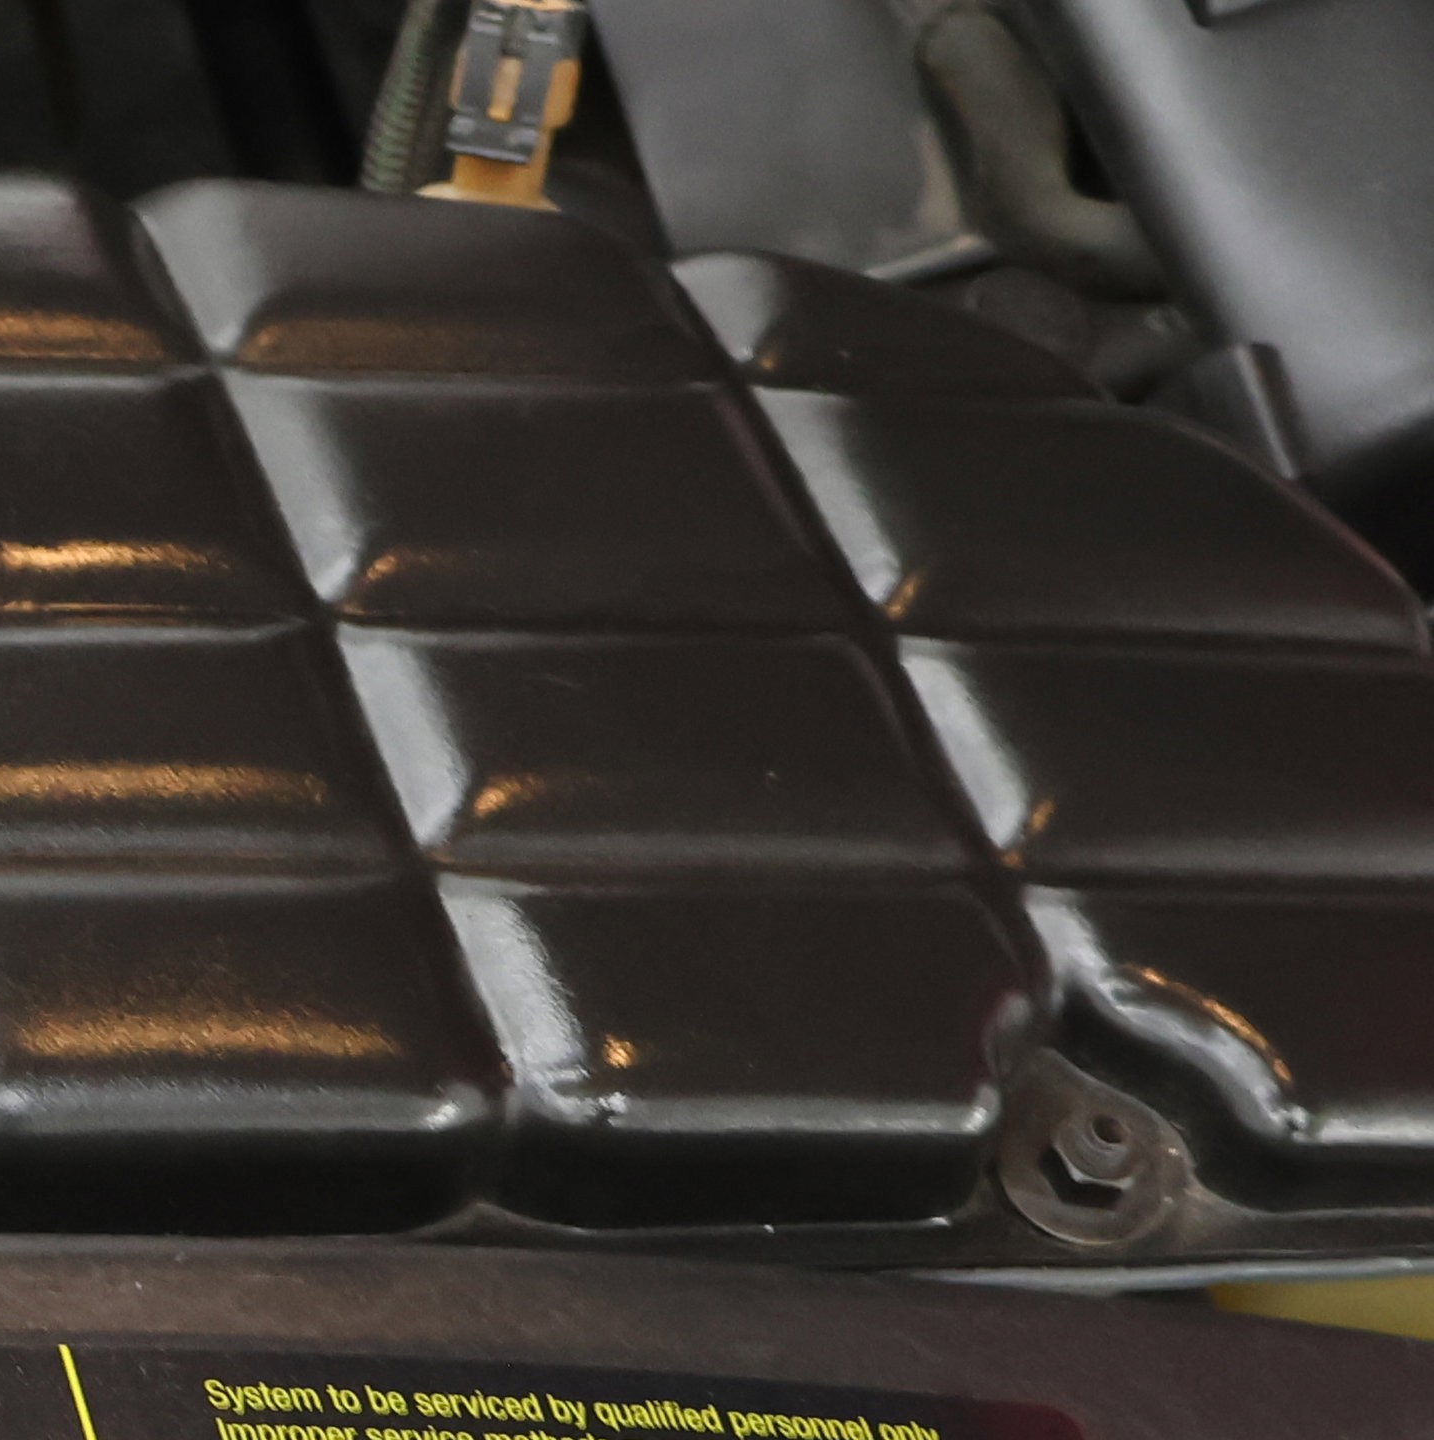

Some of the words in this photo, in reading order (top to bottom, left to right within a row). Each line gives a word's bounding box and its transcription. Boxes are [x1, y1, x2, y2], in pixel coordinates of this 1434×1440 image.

[203, 1378, 323, 1414] System
[325, 1383, 362, 1413] to
[364, 1384, 408, 1415] be
[413, 1389, 544, 1422] serviced
[545, 1393, 586, 1429] by
[593, 1399, 724, 1433] qualified
